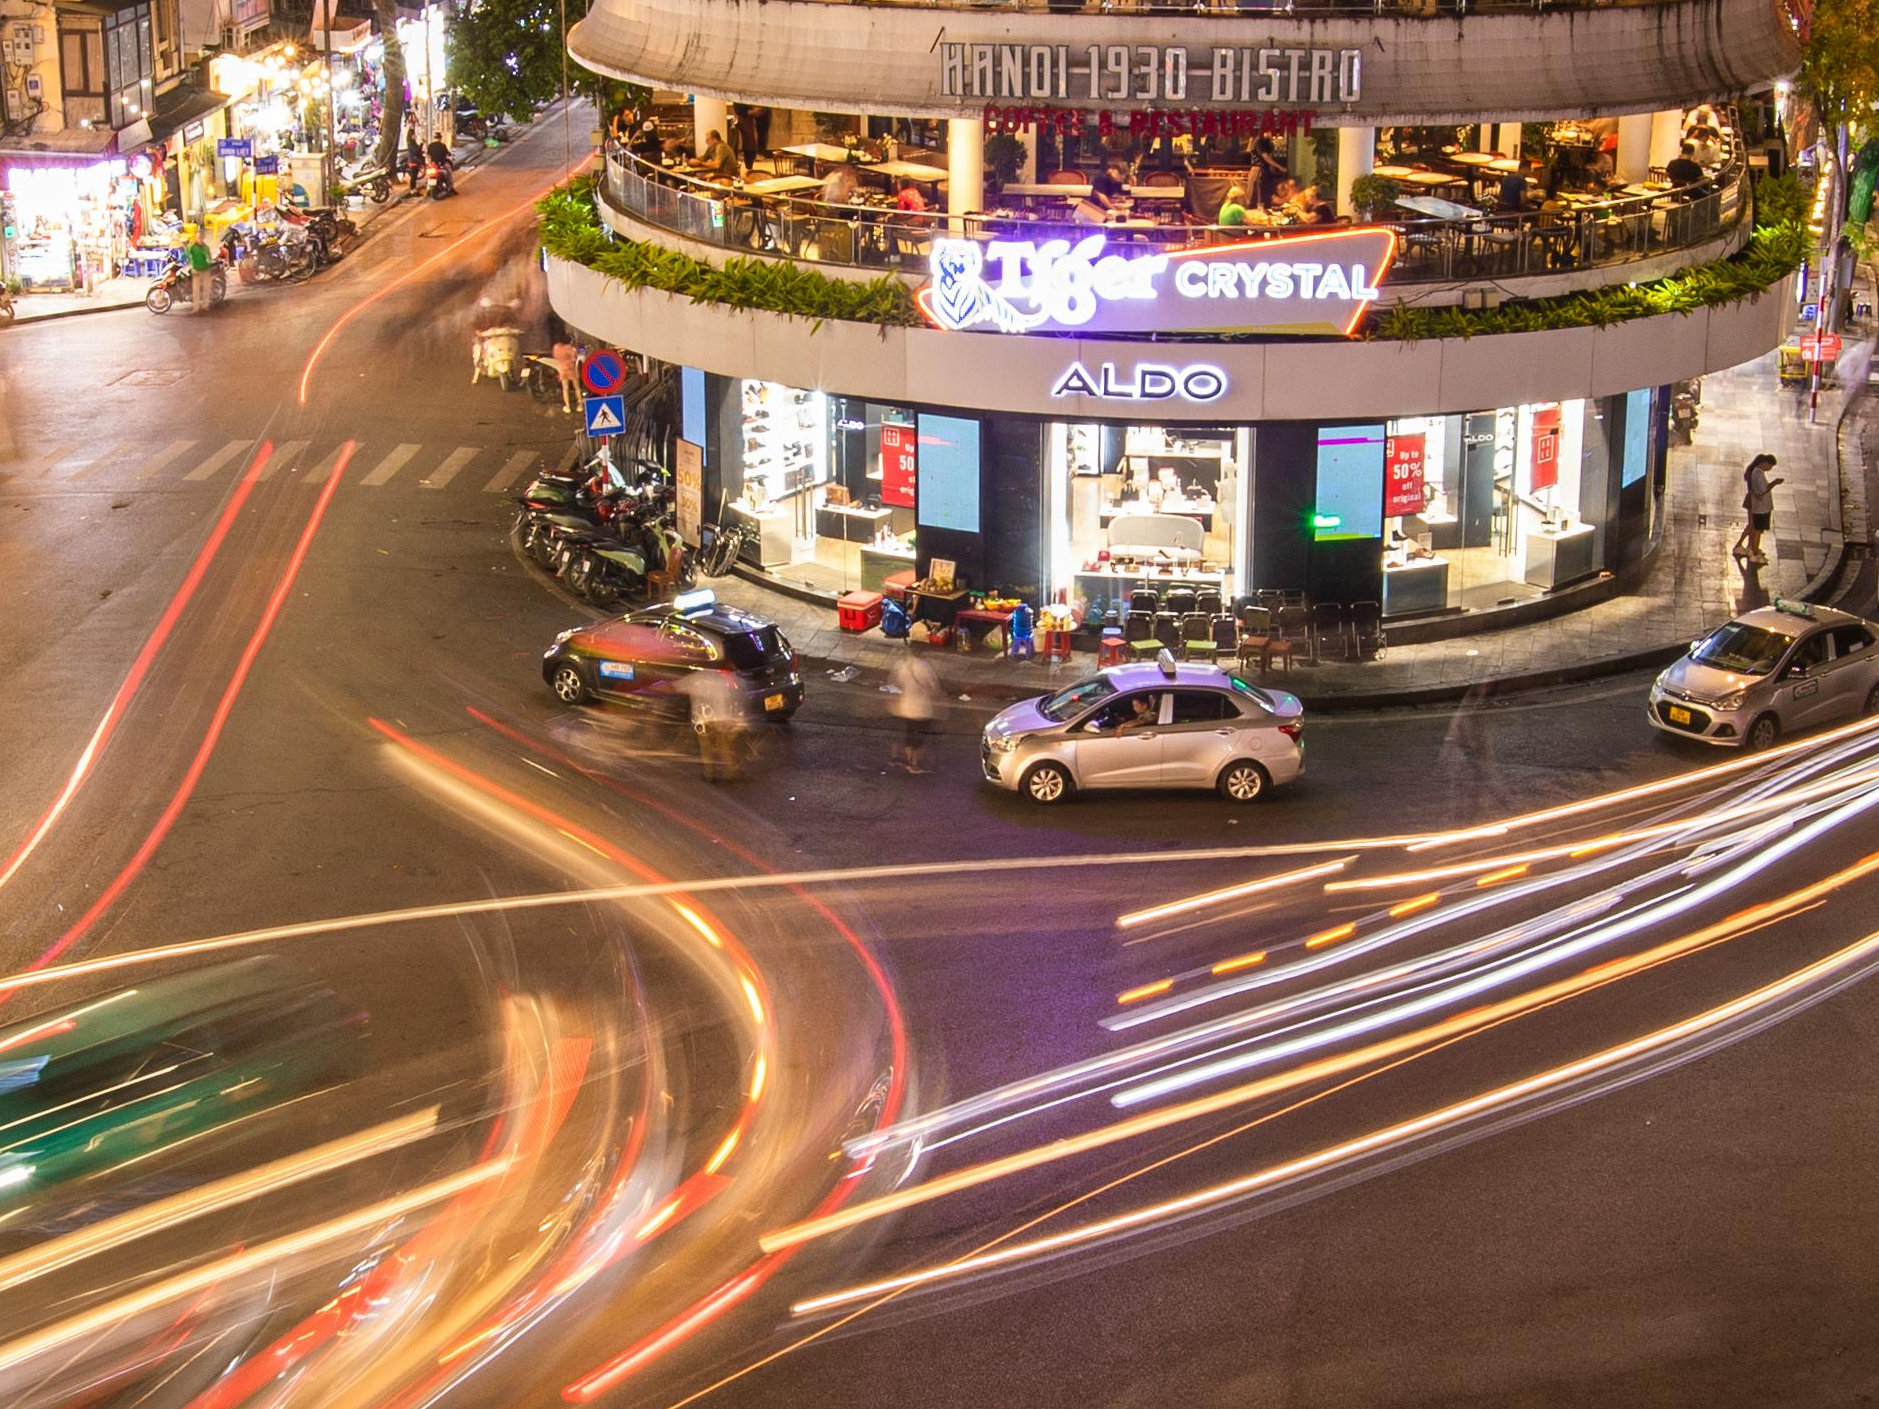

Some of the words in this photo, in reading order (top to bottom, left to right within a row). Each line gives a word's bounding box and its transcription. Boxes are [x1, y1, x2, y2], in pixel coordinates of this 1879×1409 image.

[940, 41, 1068, 99] HANOI
[1088, 44, 1187, 101] 1930
[1212, 47, 1362, 104] BISTRO
[985, 234, 1167, 325] Tiger
[1175, 260, 1379, 301] CRYSTAL
[1052, 361, 1226, 401] ALDO
[1393, 461, 1422, 480] 50%
